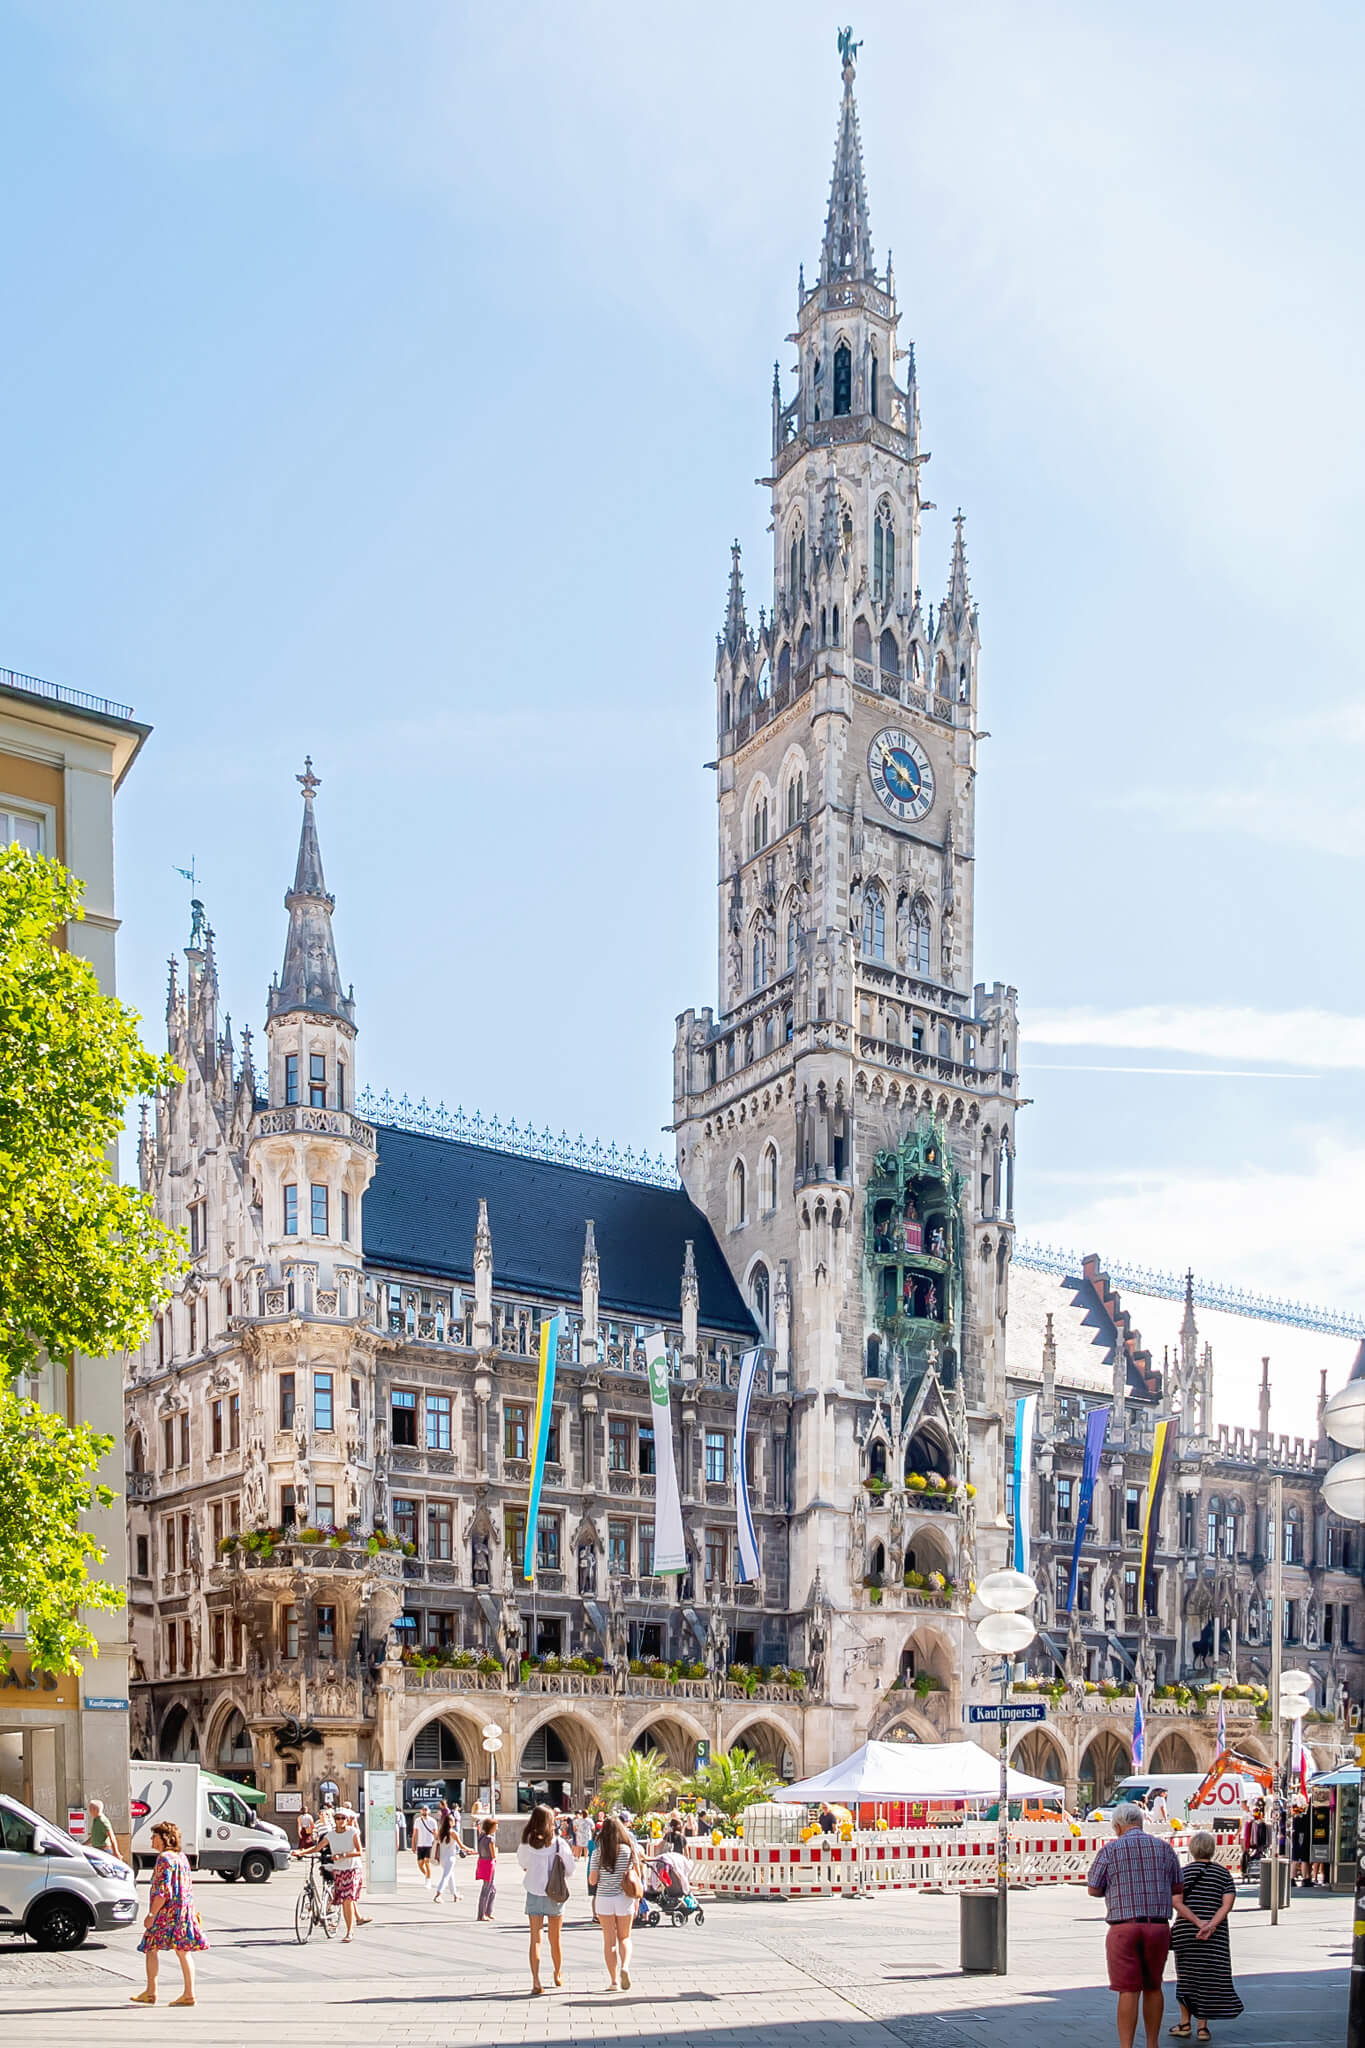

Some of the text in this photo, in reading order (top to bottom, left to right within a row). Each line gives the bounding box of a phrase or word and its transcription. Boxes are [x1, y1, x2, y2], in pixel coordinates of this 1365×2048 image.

[976, 1706, 1041, 1721] Kaufingerstr.
[697, 1742, 705, 1756] S
[411, 1787, 443, 1798] KIEFL
